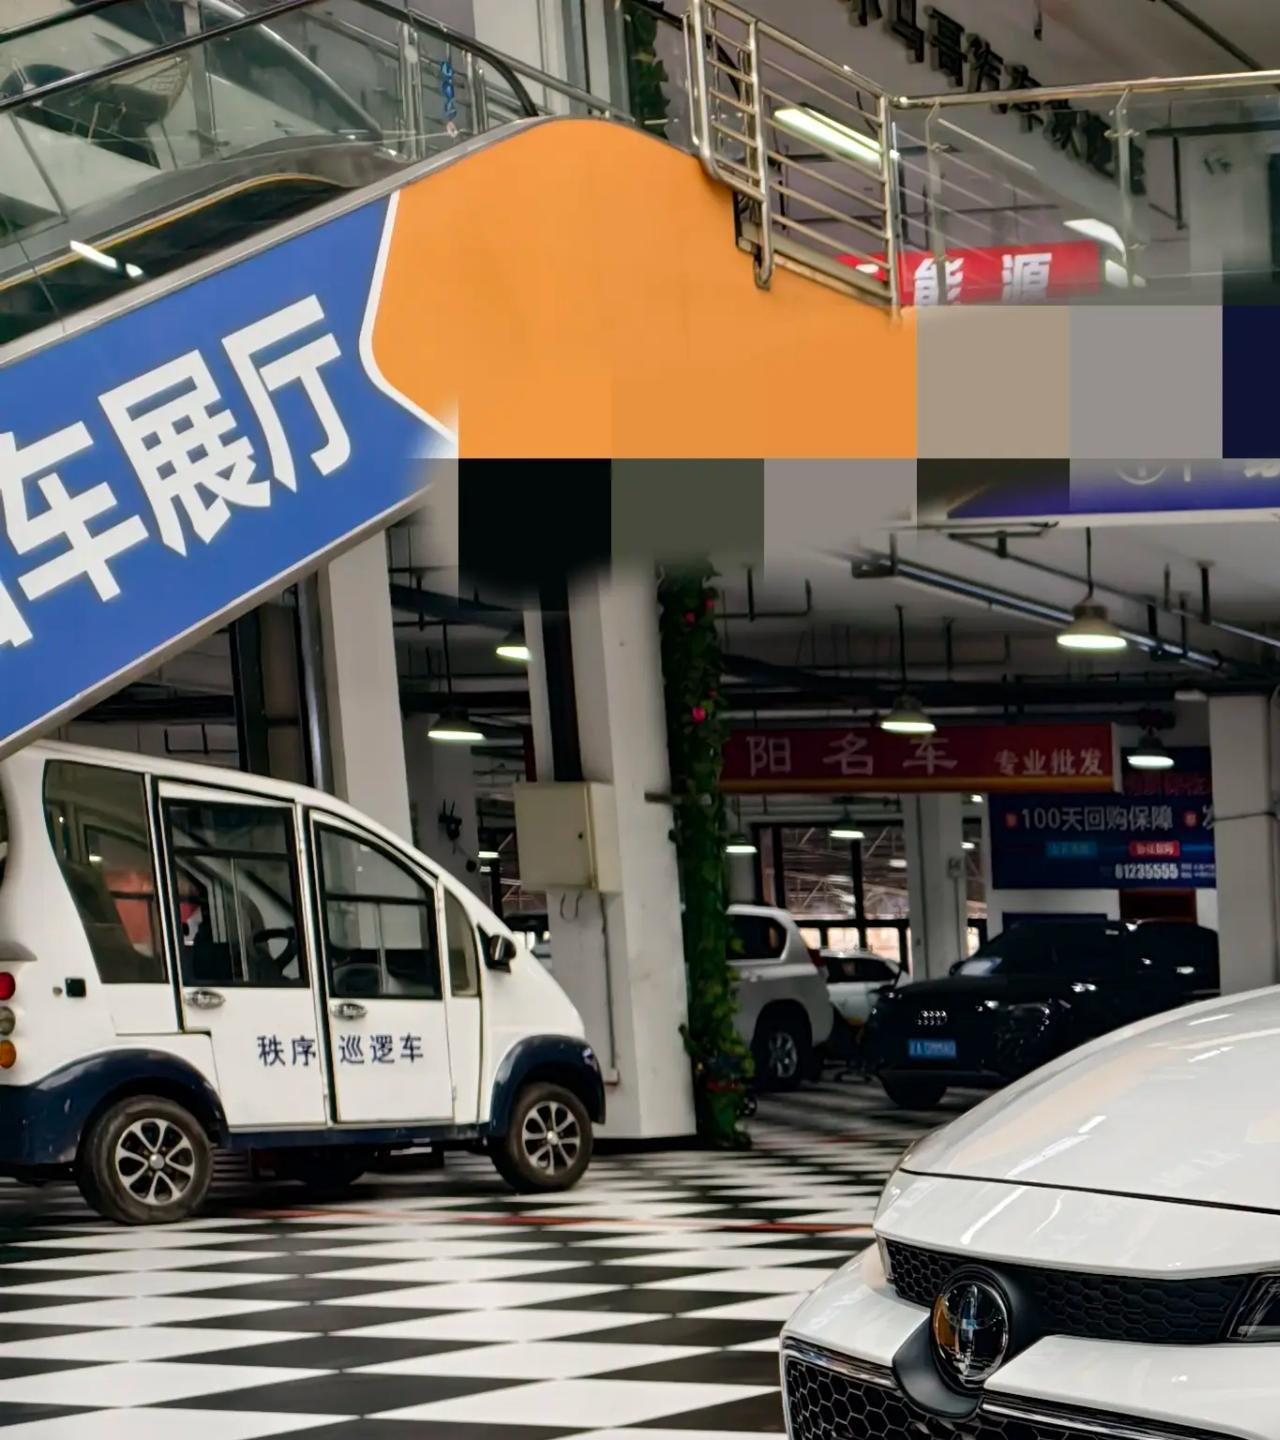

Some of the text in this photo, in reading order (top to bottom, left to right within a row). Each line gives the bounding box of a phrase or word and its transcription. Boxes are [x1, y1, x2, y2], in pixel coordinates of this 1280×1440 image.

[0, 294, 342, 648] 车展厅
[994, 749, 1104, 776] 专业批发
[1021, 805, 1174, 832] 100天回购保障
